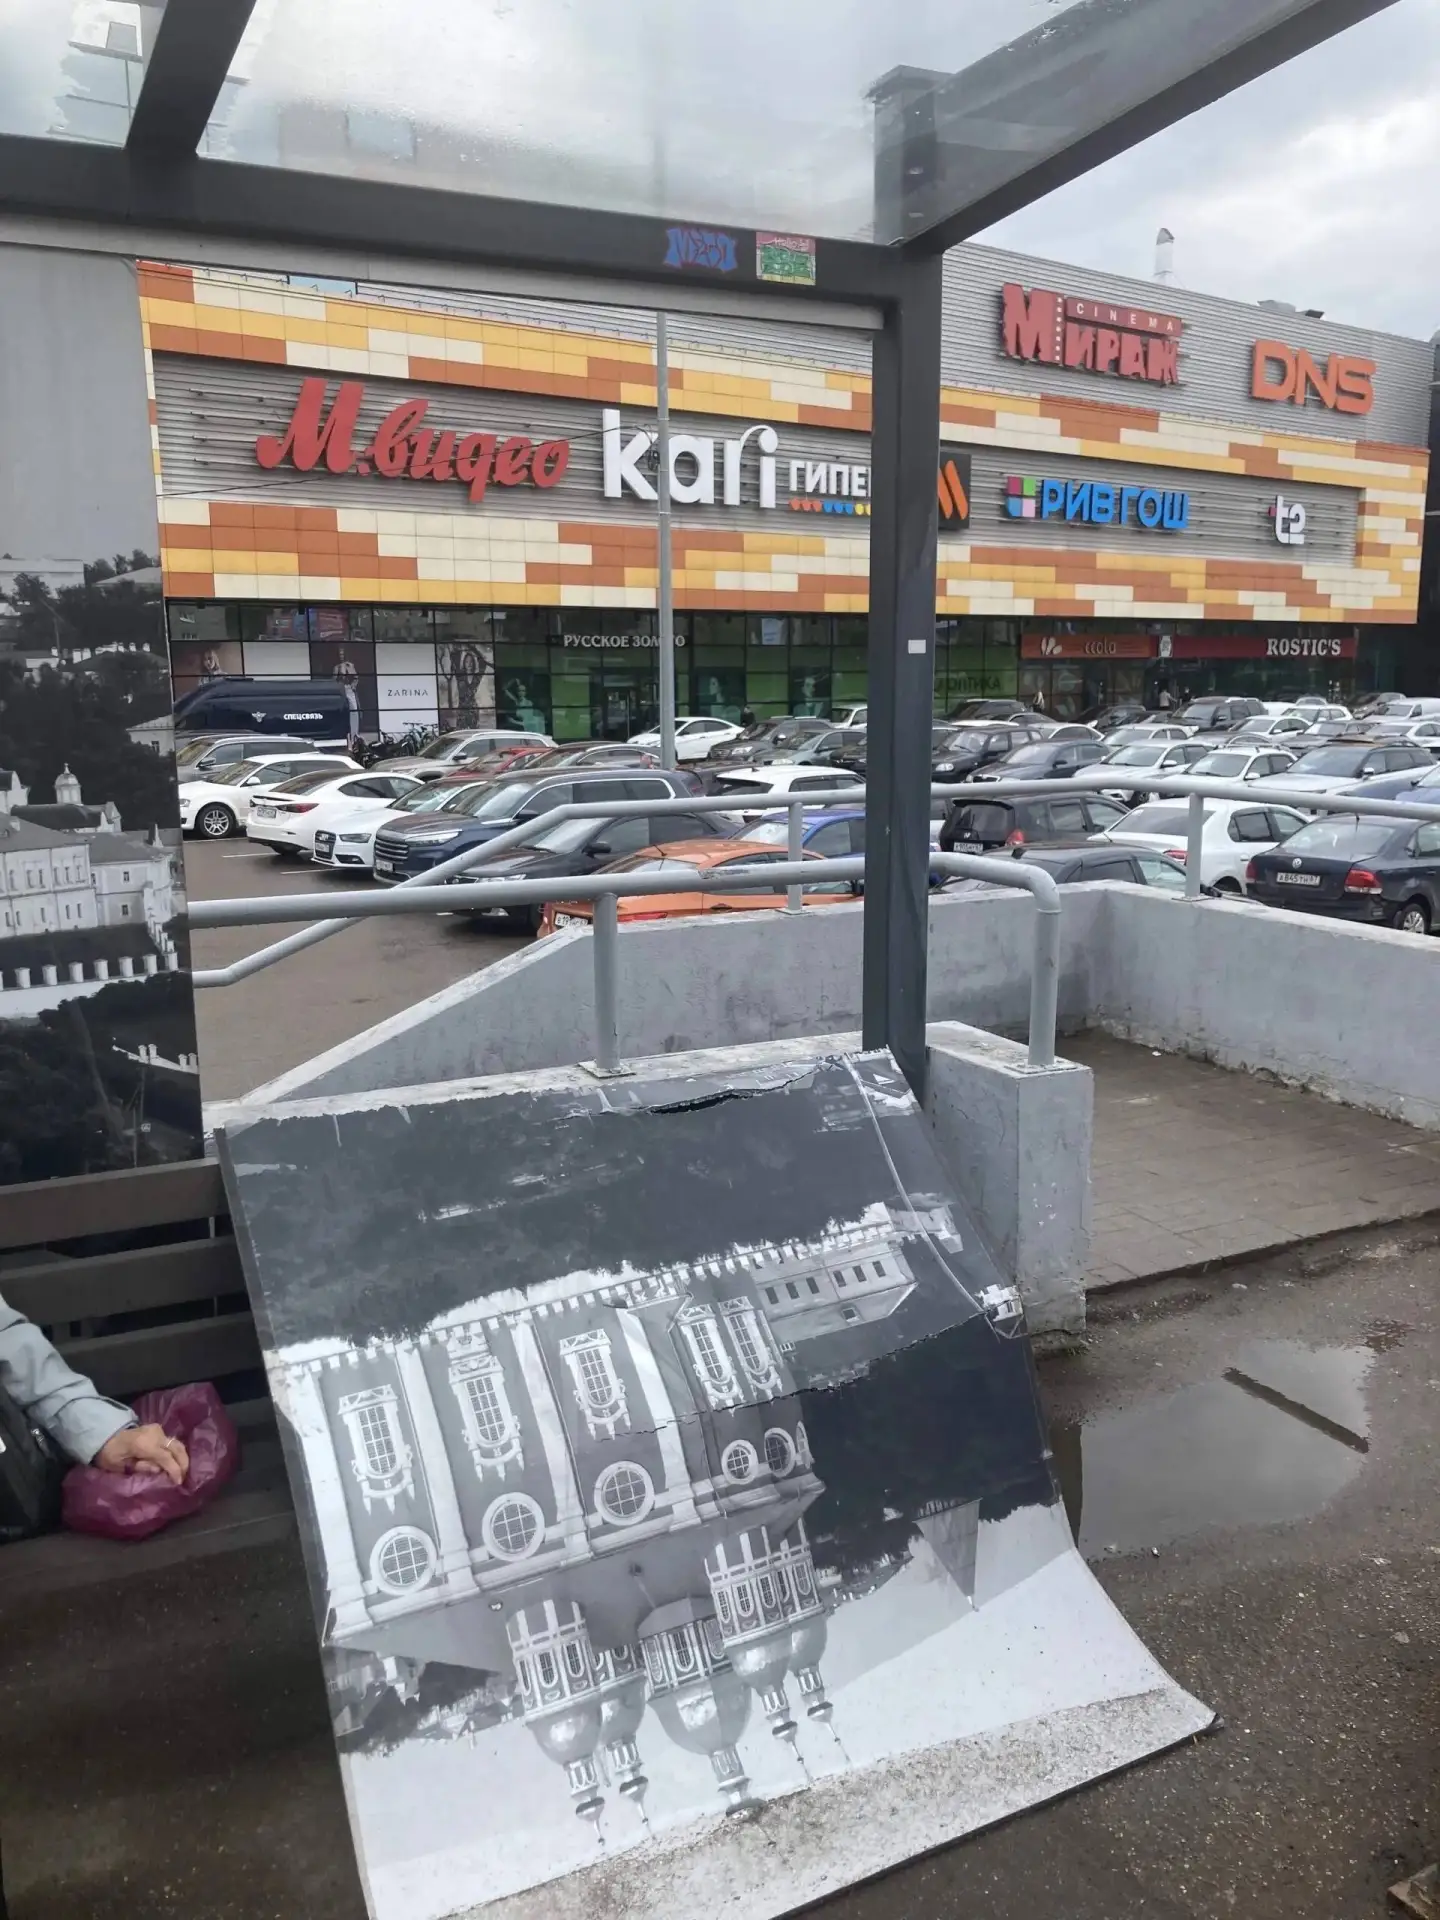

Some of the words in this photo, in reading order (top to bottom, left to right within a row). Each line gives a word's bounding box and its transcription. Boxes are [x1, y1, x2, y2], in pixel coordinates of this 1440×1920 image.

[1076, 303, 1175, 331] CINEMA
[1251, 339, 1376, 414] DNS
[256, 377, 571, 503] М.видео
[602, 408, 779, 509] kari
[788, 460, 872, 497] ГИПЕ
[563, 635, 630, 647] РУССКОЕ
[632, 635, 686, 647] ЗОЛО
[1266, 638, 1341, 656] ROSTIC'S
[387, 689, 429, 697] ZARINA
[283, 713, 324, 721] СПЕЦСВЯЗЬ
